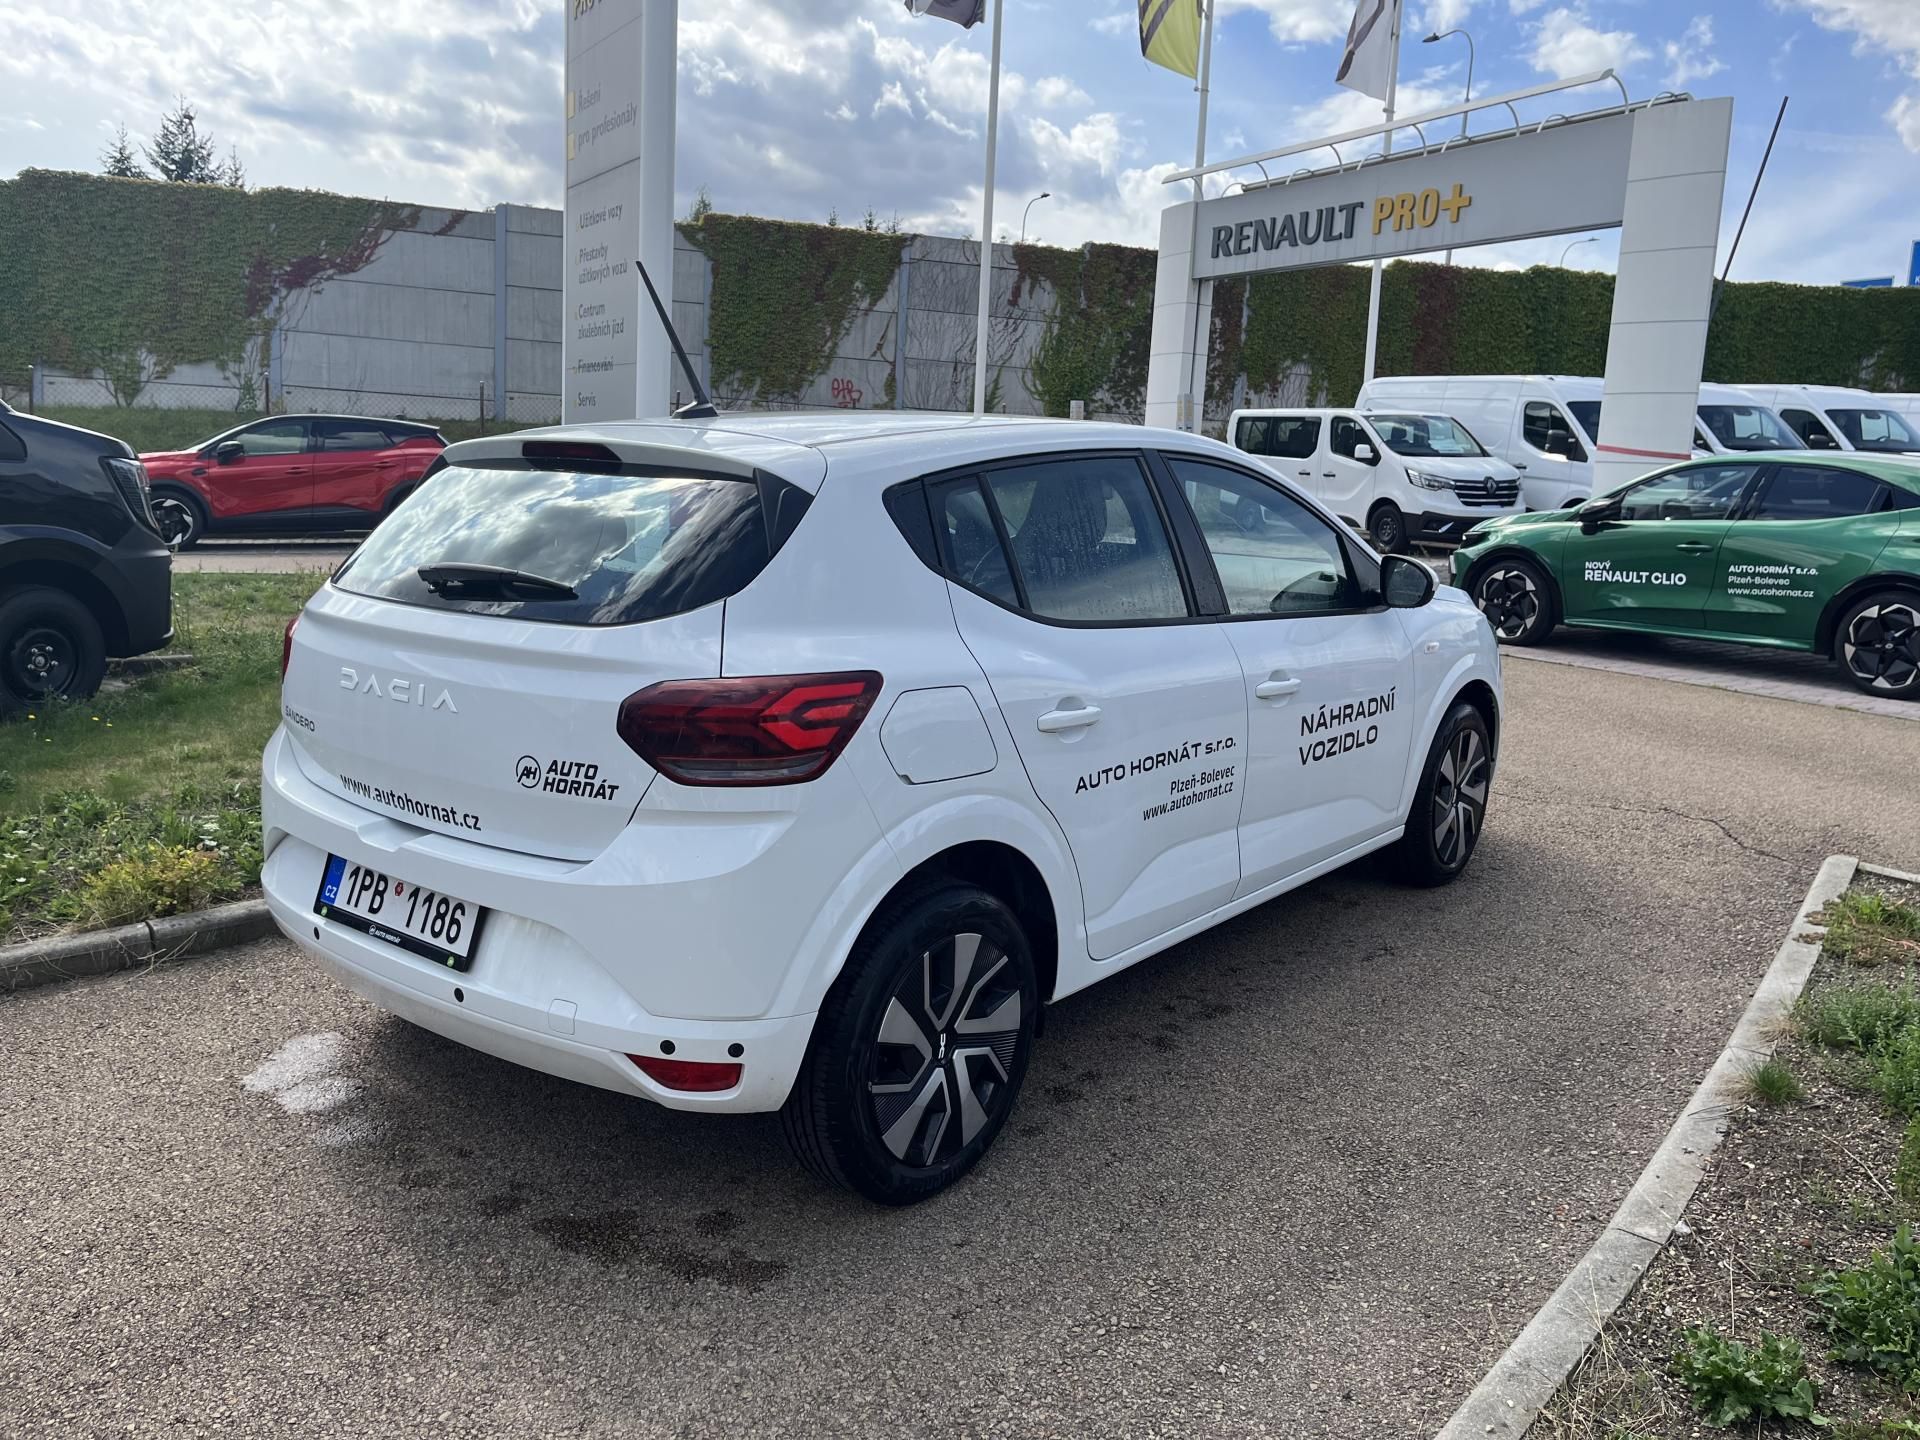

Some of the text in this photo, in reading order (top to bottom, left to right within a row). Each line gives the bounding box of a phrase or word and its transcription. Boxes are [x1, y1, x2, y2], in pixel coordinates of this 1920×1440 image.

[579, 101, 637, 150] pro profesionály
[608, 204, 623, 222] vozy
[1210, 183, 1471, 259] RENAULT PRO+
[578, 303, 606, 319] Centrum
[578, 392, 596, 407] Servis
[1584, 569, 1687, 585] RENAULT CLIO
[1585, 560, 1611, 570] NOVÝ
[1728, 563, 1819, 576] AUTO HORNÁT s.r.o.
[1727, 586, 1815, 598] www.autohornat.cz
[1728, 575, 1790, 586] Plzeň-Bolevec
[340, 666, 458, 714] DACIA
[285, 705, 316, 732] SANDERO
[1300, 686, 1397, 737] NÁHRADNÍ
[1298, 724, 1378, 767] VOZIDLO
[546, 759, 599, 781] AUTO
[1075, 736, 1237, 794] AUTO HORNÁT s.r.o.
[542, 776, 620, 801] HORNÁT
[1170, 764, 1236, 795] Plzeň-Bolevec
[340, 773, 482, 832] www.autohornat.cz
[1142, 780, 1235, 821] www.autohornat.cz
[325, 884, 338, 899] CZ
